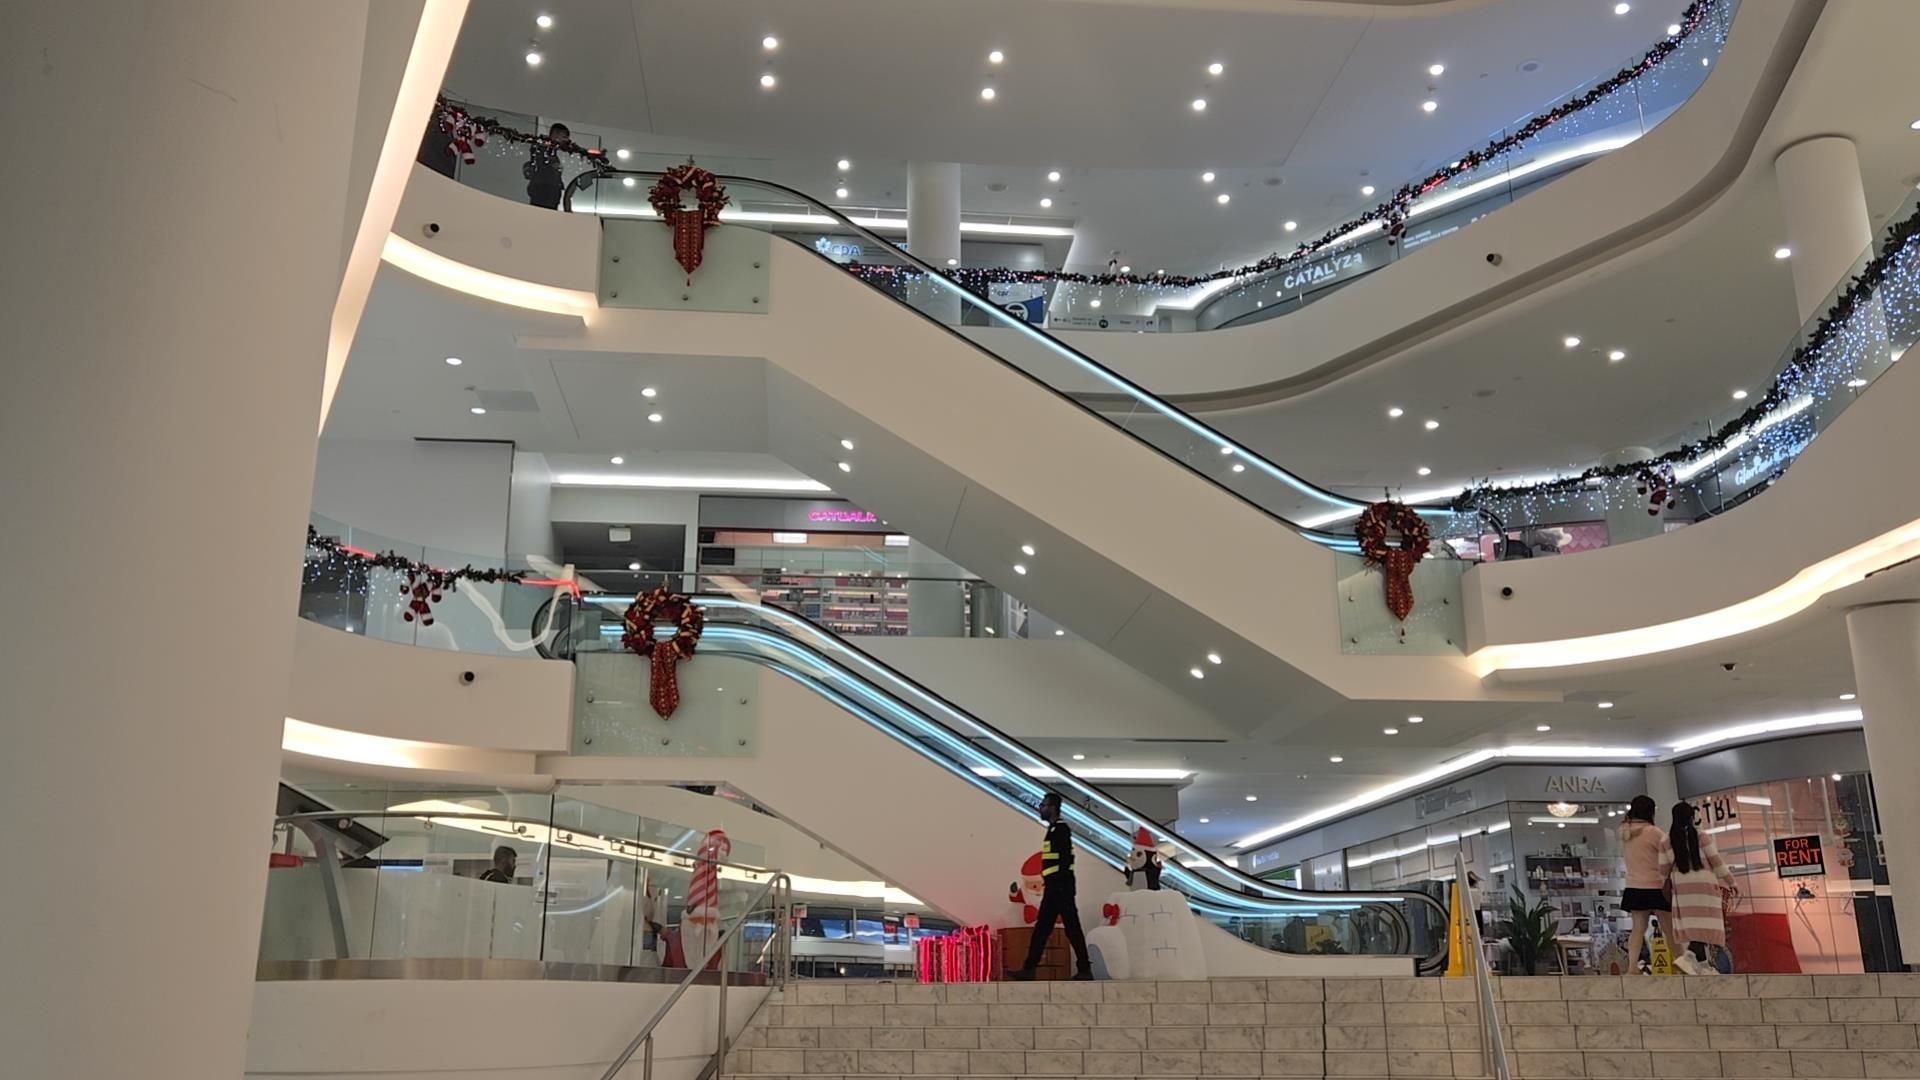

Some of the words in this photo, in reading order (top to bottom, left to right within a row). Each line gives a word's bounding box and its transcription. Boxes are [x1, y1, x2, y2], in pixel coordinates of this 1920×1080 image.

[1545, 776, 1608, 793] ANRA
[1784, 838, 1809, 850] FOR
[1776, 848, 1821, 866] RENT
